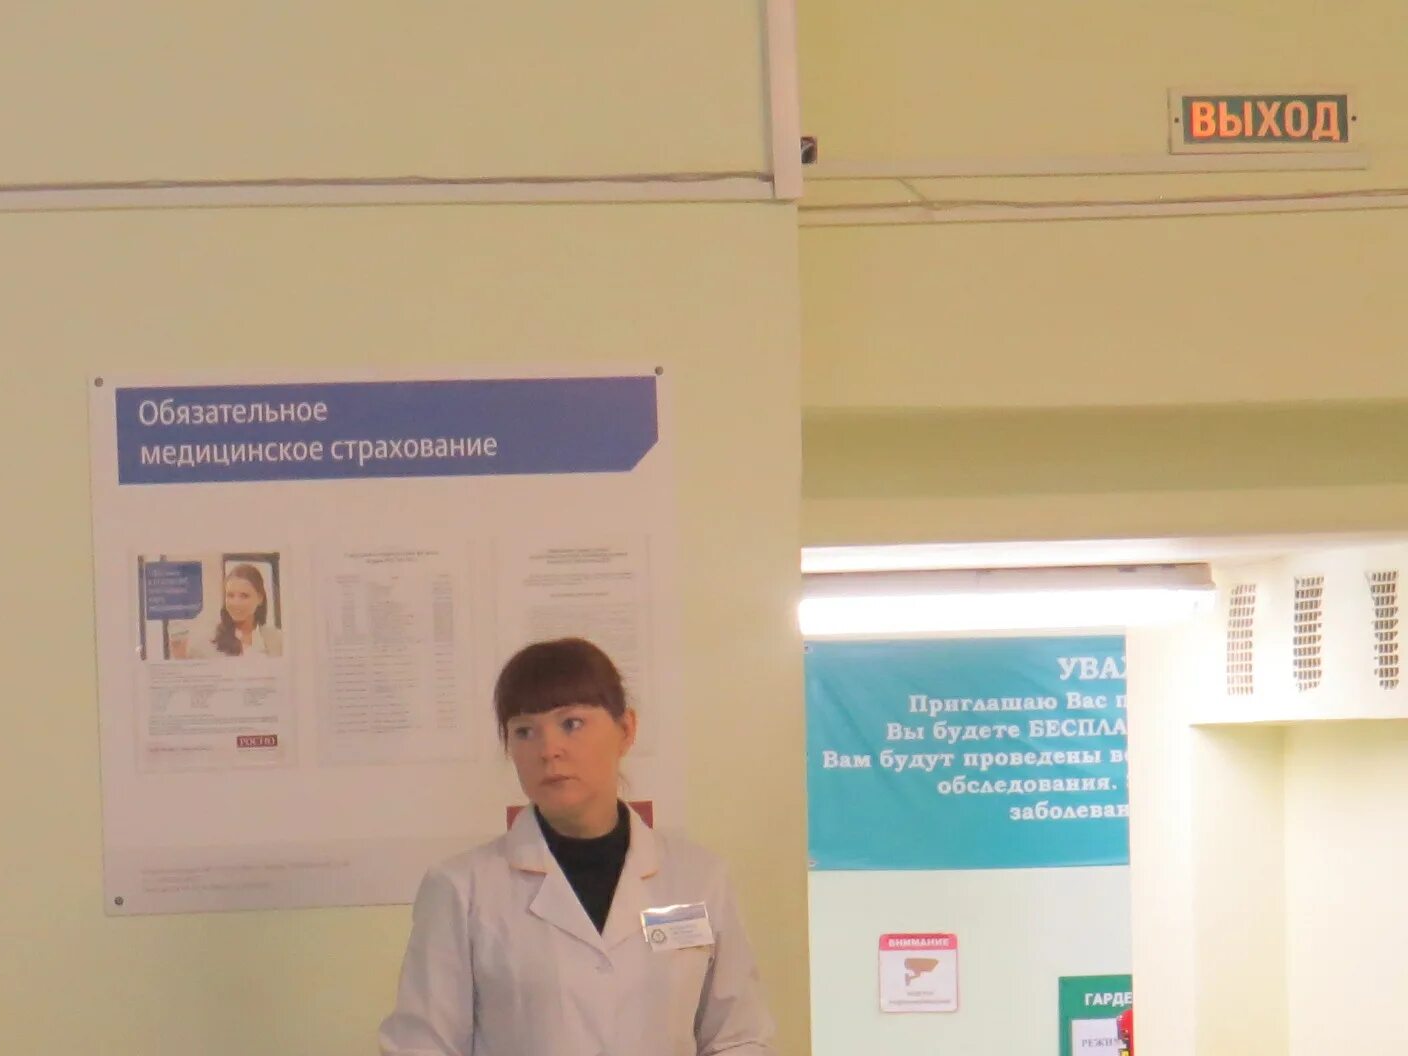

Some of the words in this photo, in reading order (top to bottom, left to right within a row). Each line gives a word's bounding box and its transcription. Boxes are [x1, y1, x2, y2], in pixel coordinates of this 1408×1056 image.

[1190, 101, 1341, 141] ВЫХОД
[138, 399, 328, 426] Обязательное
[141, 439, 324, 467] медицинское
[330, 436, 498, 466] страхование
[908, 694, 1058, 717] Приглашаю
[1066, 692, 1107, 709] Вас
[886, 723, 924, 741] Вы
[933, 719, 1020, 744] будете
[822, 750, 871, 768] Вам
[880, 749, 954, 772] будут
[963, 750, 1101, 771] проведены
[937, 775, 1117, 795] обследования.
[888, 938, 950, 948] ВНИМАНИЕ
